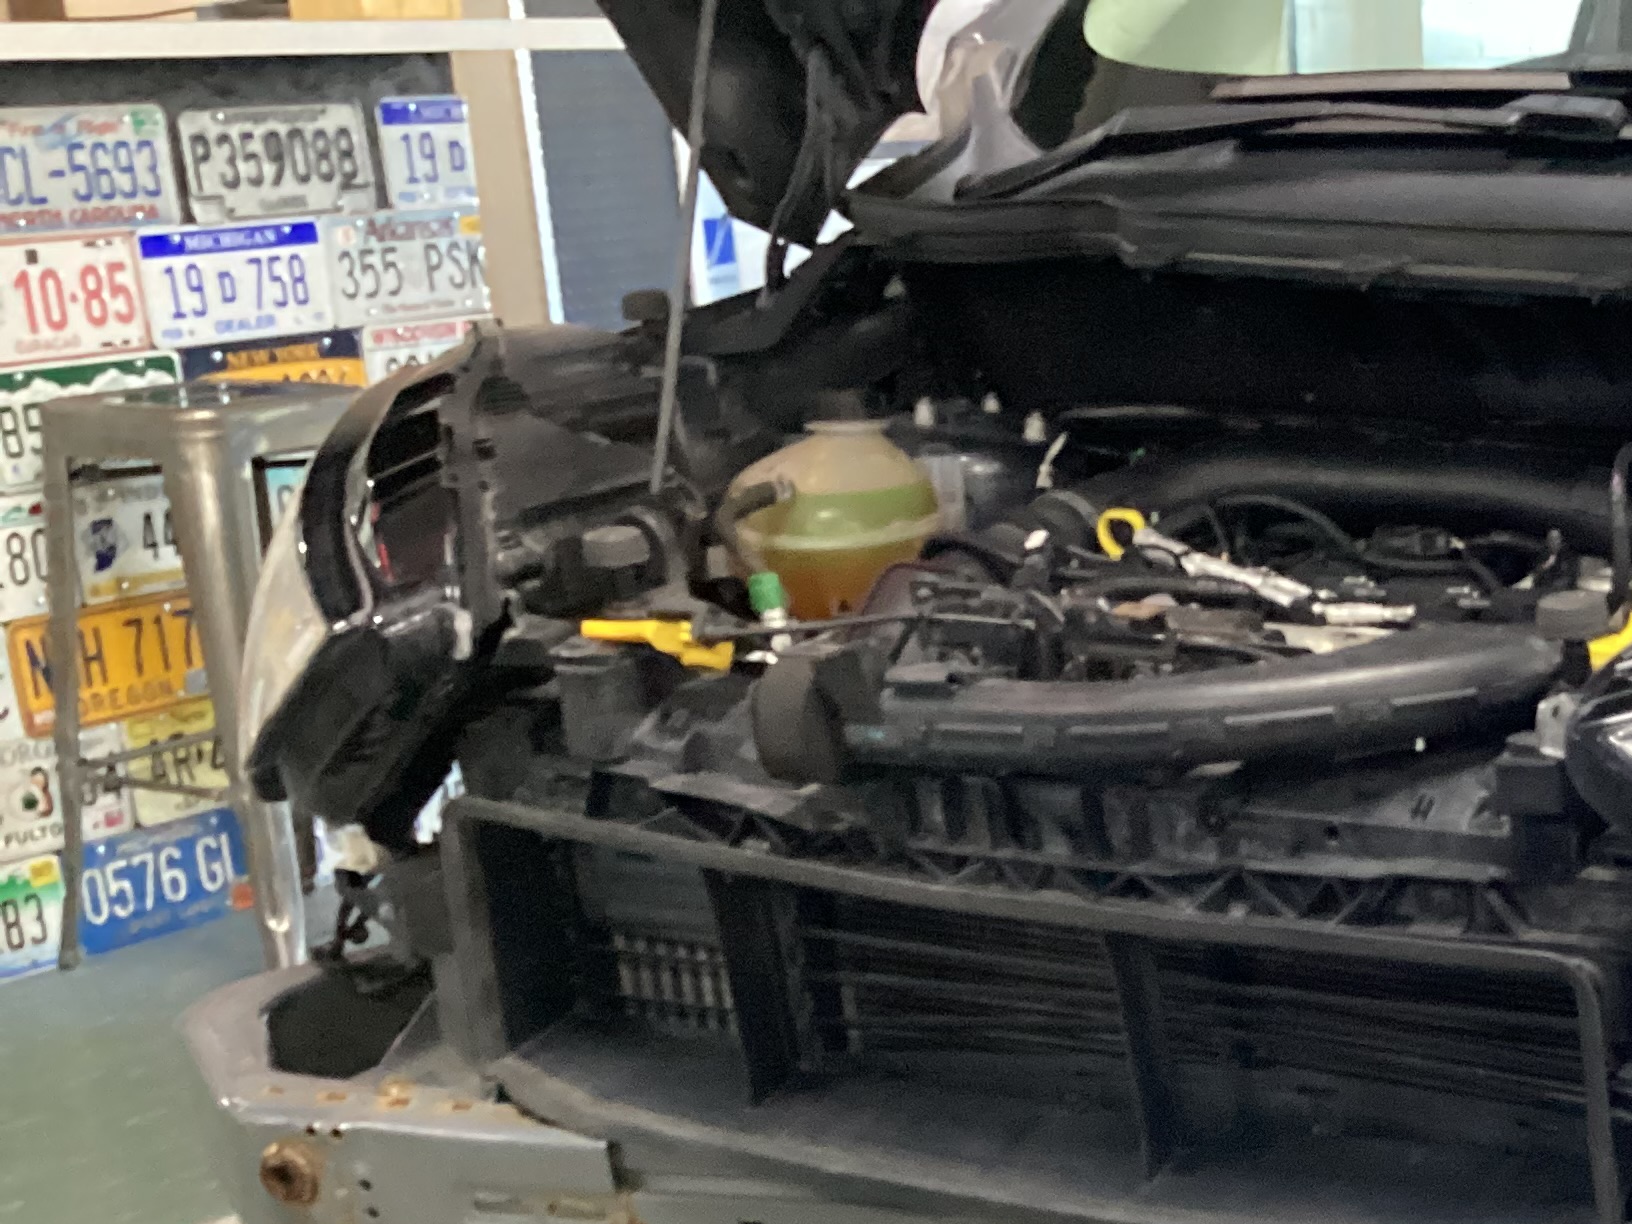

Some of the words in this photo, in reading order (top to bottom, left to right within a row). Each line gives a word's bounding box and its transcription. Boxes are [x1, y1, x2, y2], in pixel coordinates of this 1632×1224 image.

[188, 127, 358, 192] P359088
[400, 132, 439, 184] 19
[448, 140, 465, 172] D
[164, 264, 208, 320] 19
[217, 271, 237, 304] D
[246, 253, 310, 311] 758
[337, 246, 402, 299] 355
[122, 609, 195, 678] 717
[82, 846, 187, 925] 0576
